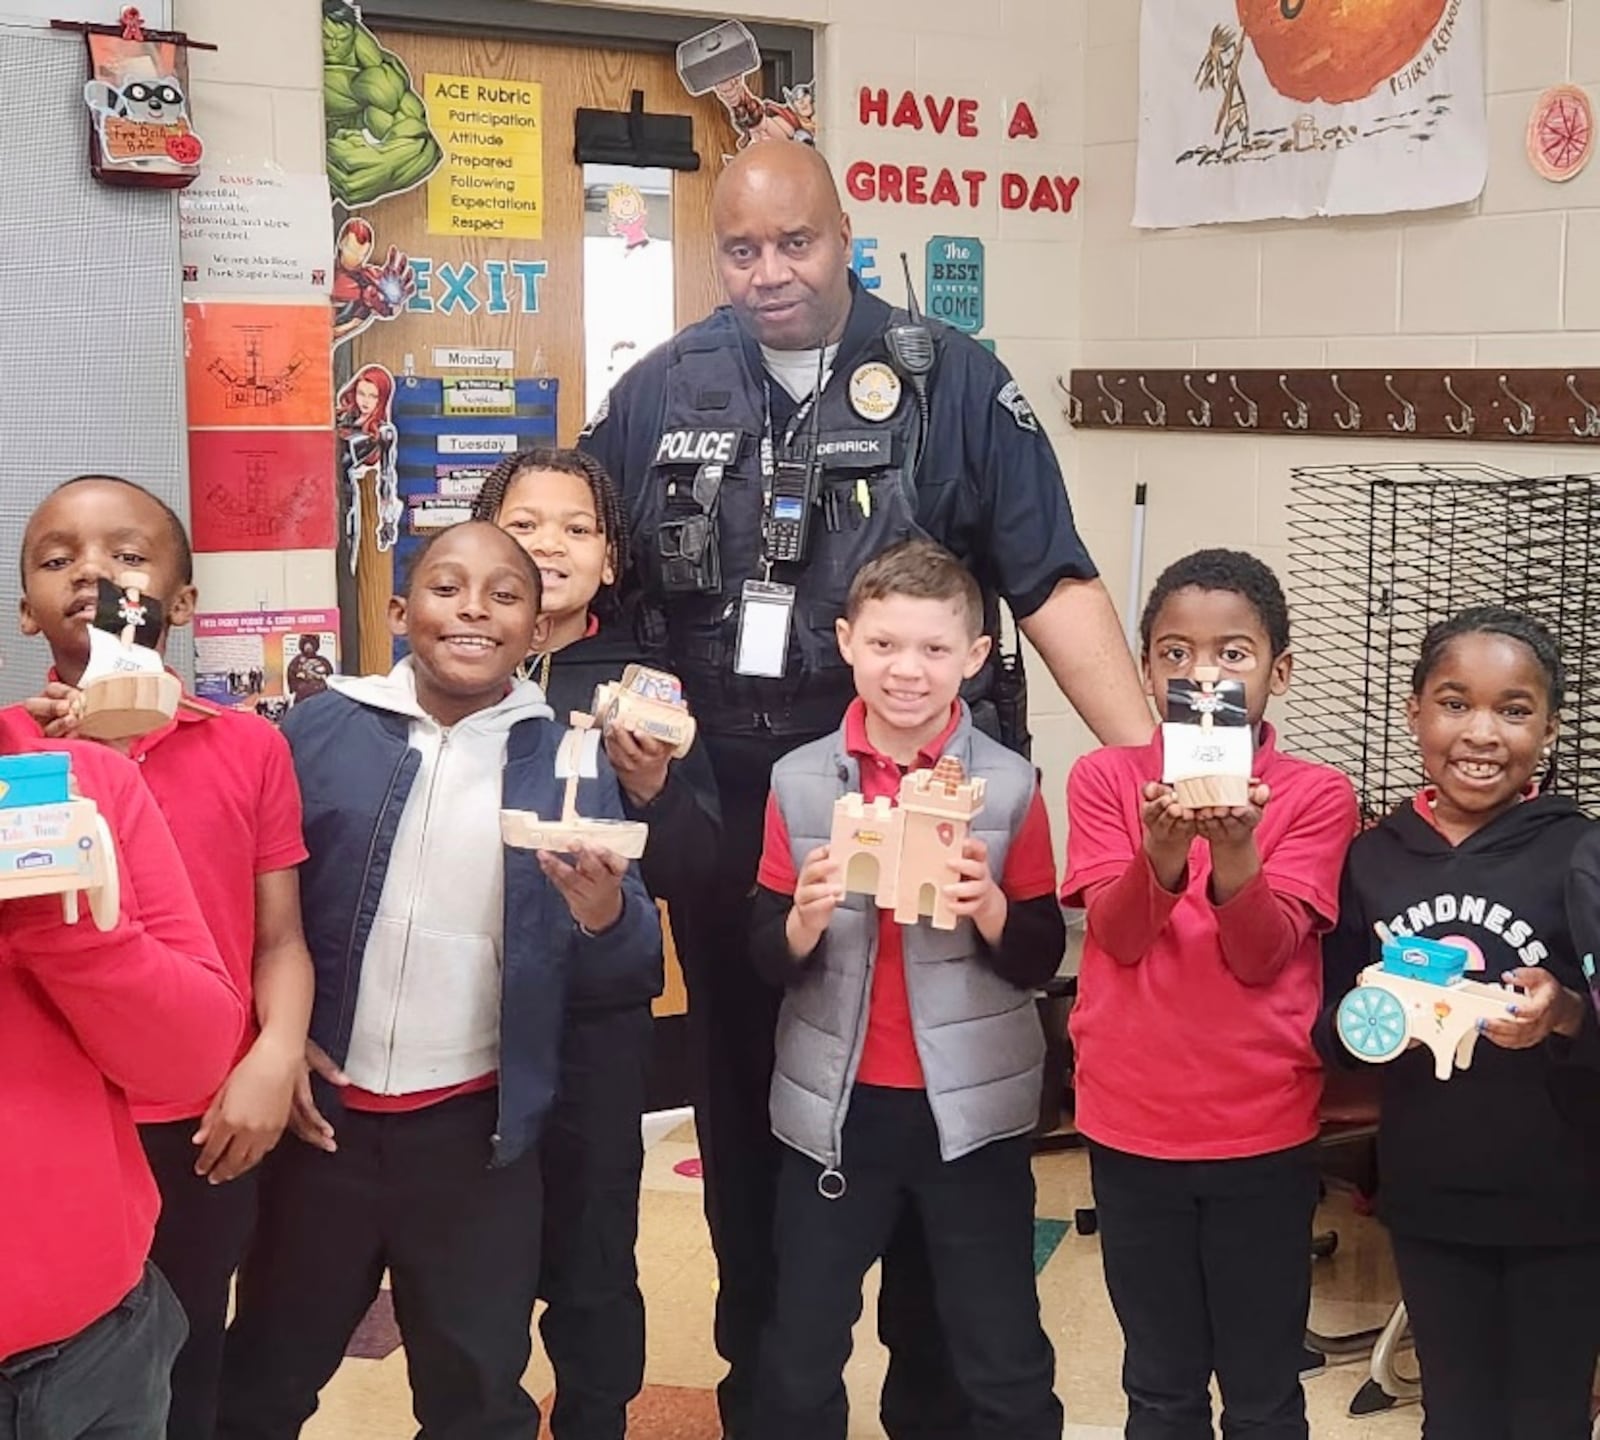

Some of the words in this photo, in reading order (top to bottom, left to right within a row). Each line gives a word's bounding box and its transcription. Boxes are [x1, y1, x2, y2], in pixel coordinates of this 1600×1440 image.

[1389, 61, 1427, 96] PETER
[435, 83, 469, 100] ACE
[477, 85, 530, 105] Rubric
[449, 109, 536, 128] Participation
[859, 86, 979, 138] HAVE
[1007, 101, 1039, 139] A
[449, 131, 503, 147] Attitude
[450, 151, 512, 169] Prepared
[451, 176, 515, 192] Following
[846, 160, 987, 208] GREAT
[999, 172, 1080, 213] DAY
[452, 195, 537, 212] Expectations
[452, 215, 504, 231] Respect
[944, 242, 970, 260] The
[932, 263, 980, 281] BEST
[406, 259, 547, 316] EXIT
[932, 296, 979, 318] COME
[448, 353, 501, 369] Monday
[450, 438, 506, 453] Tuesday
[656, 430, 735, 462] POLICE
[1389, 894, 1549, 967] INDNESS
